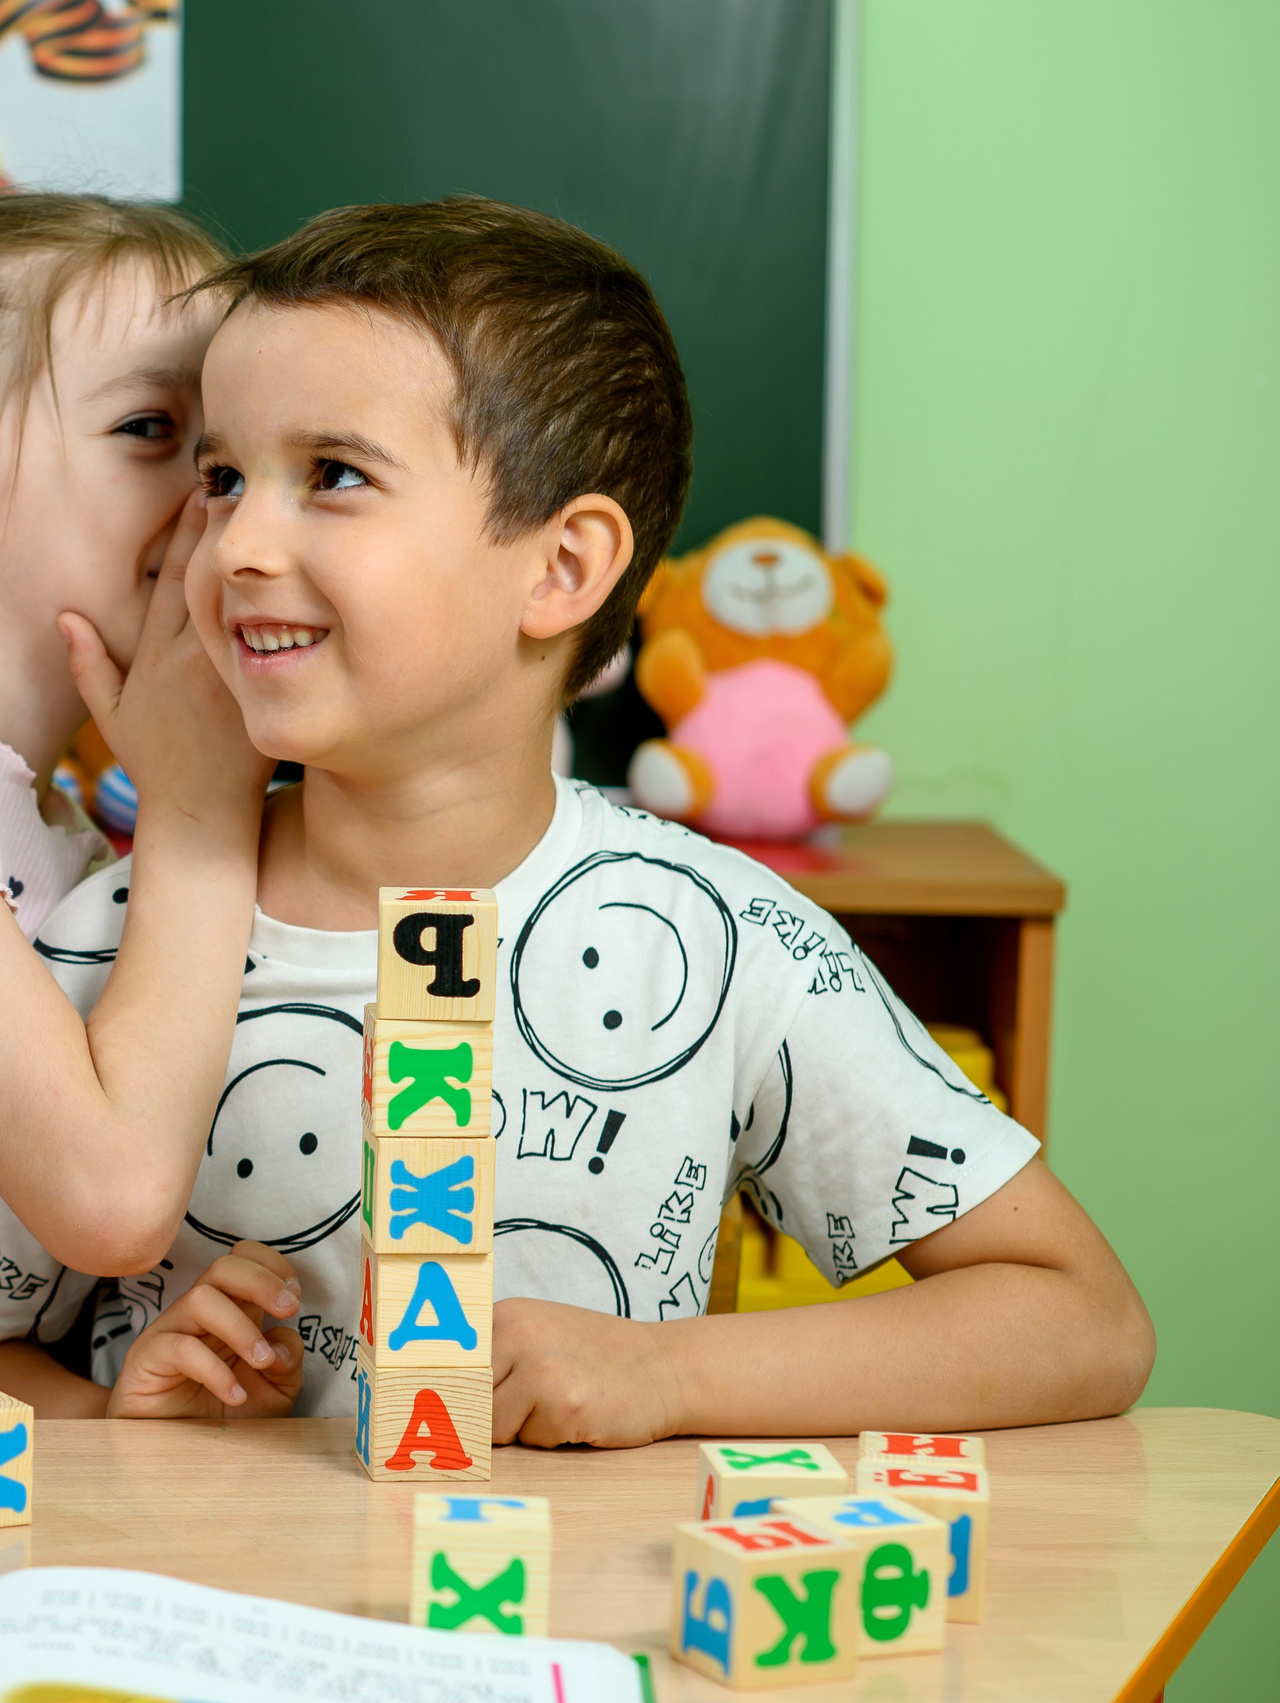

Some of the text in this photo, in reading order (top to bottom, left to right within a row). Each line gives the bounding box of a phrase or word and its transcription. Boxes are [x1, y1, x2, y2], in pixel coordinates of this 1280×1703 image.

[390, 1155, 475, 1245] Ж
[384, 1389, 473, 1471] А
[860, 1543, 930, 1643] Ф
